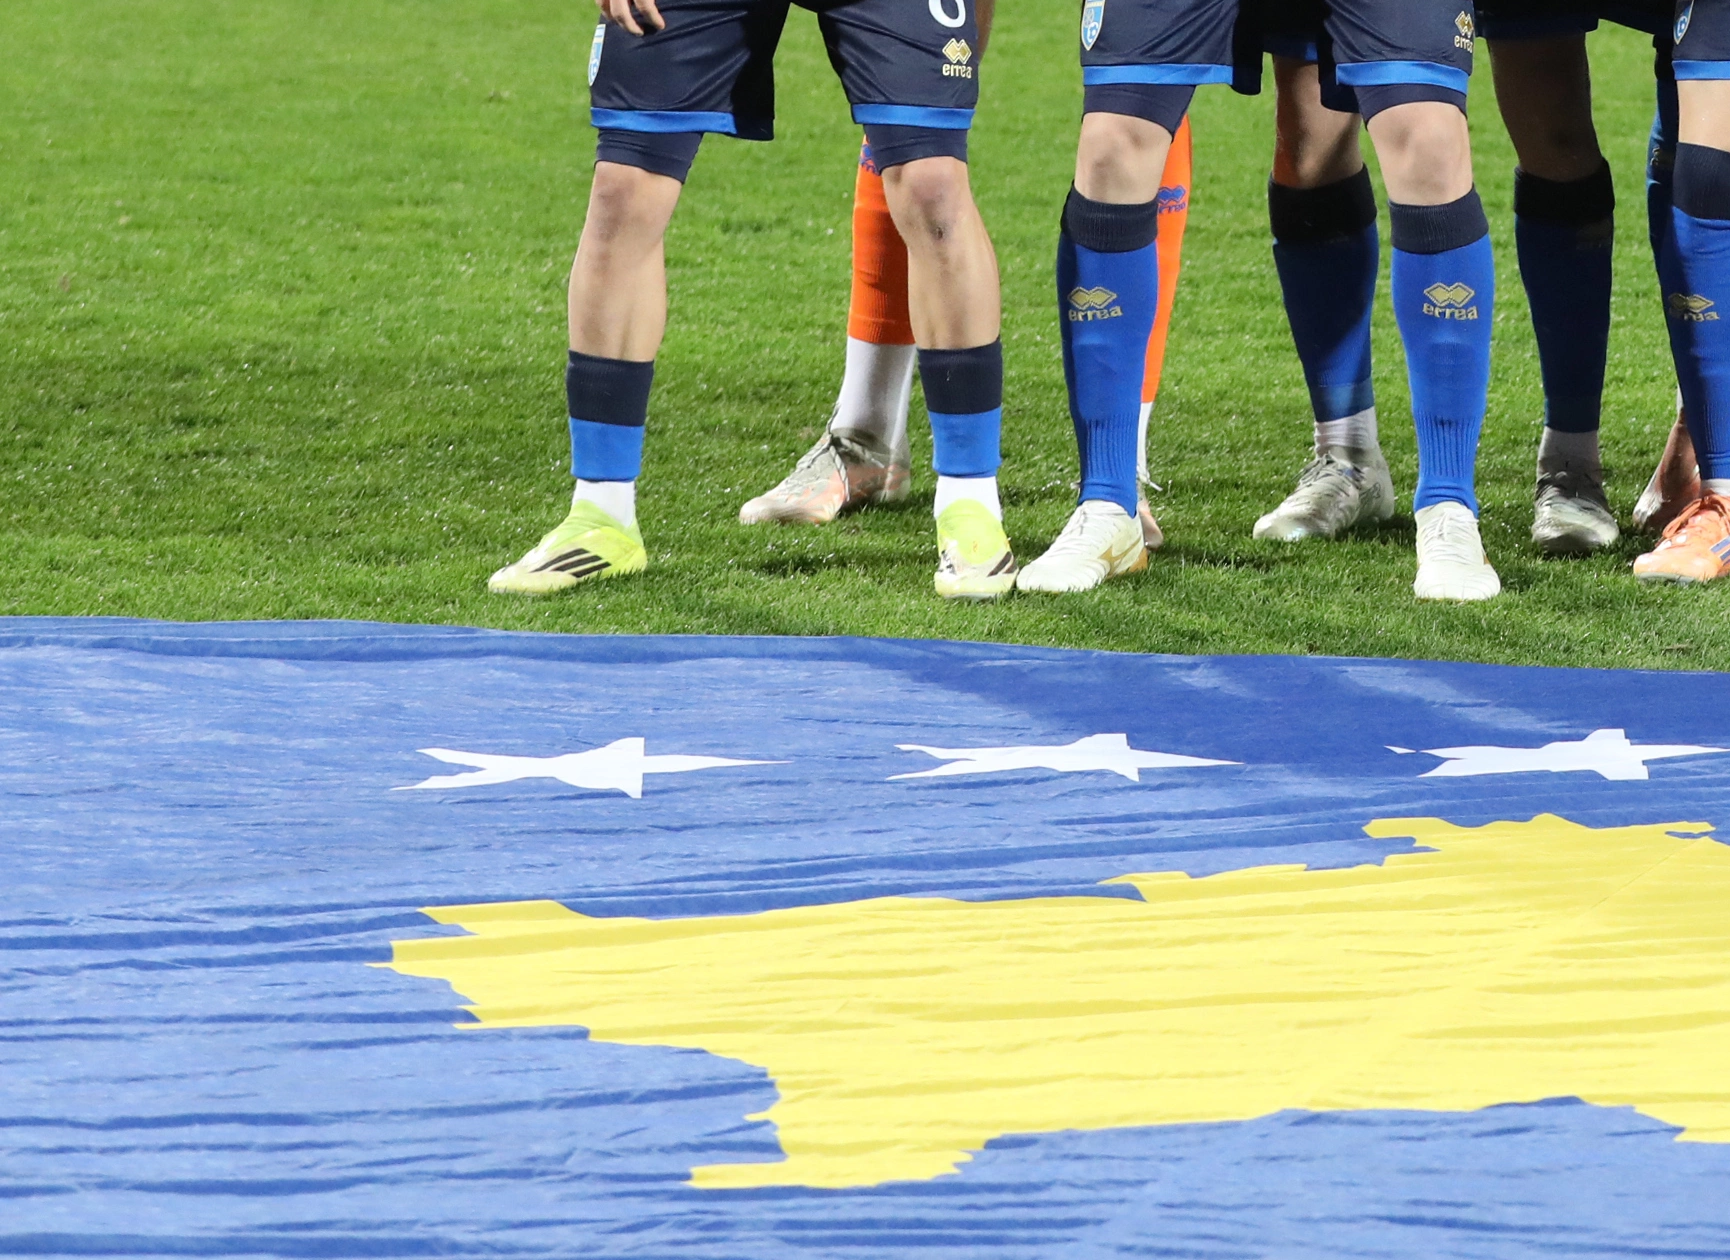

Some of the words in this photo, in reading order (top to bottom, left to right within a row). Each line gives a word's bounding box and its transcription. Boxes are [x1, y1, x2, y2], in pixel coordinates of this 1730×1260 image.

[942, 63, 972, 79] errea
[1068, 305, 1123, 322] errea
[1422, 302, 1479, 321] errea
